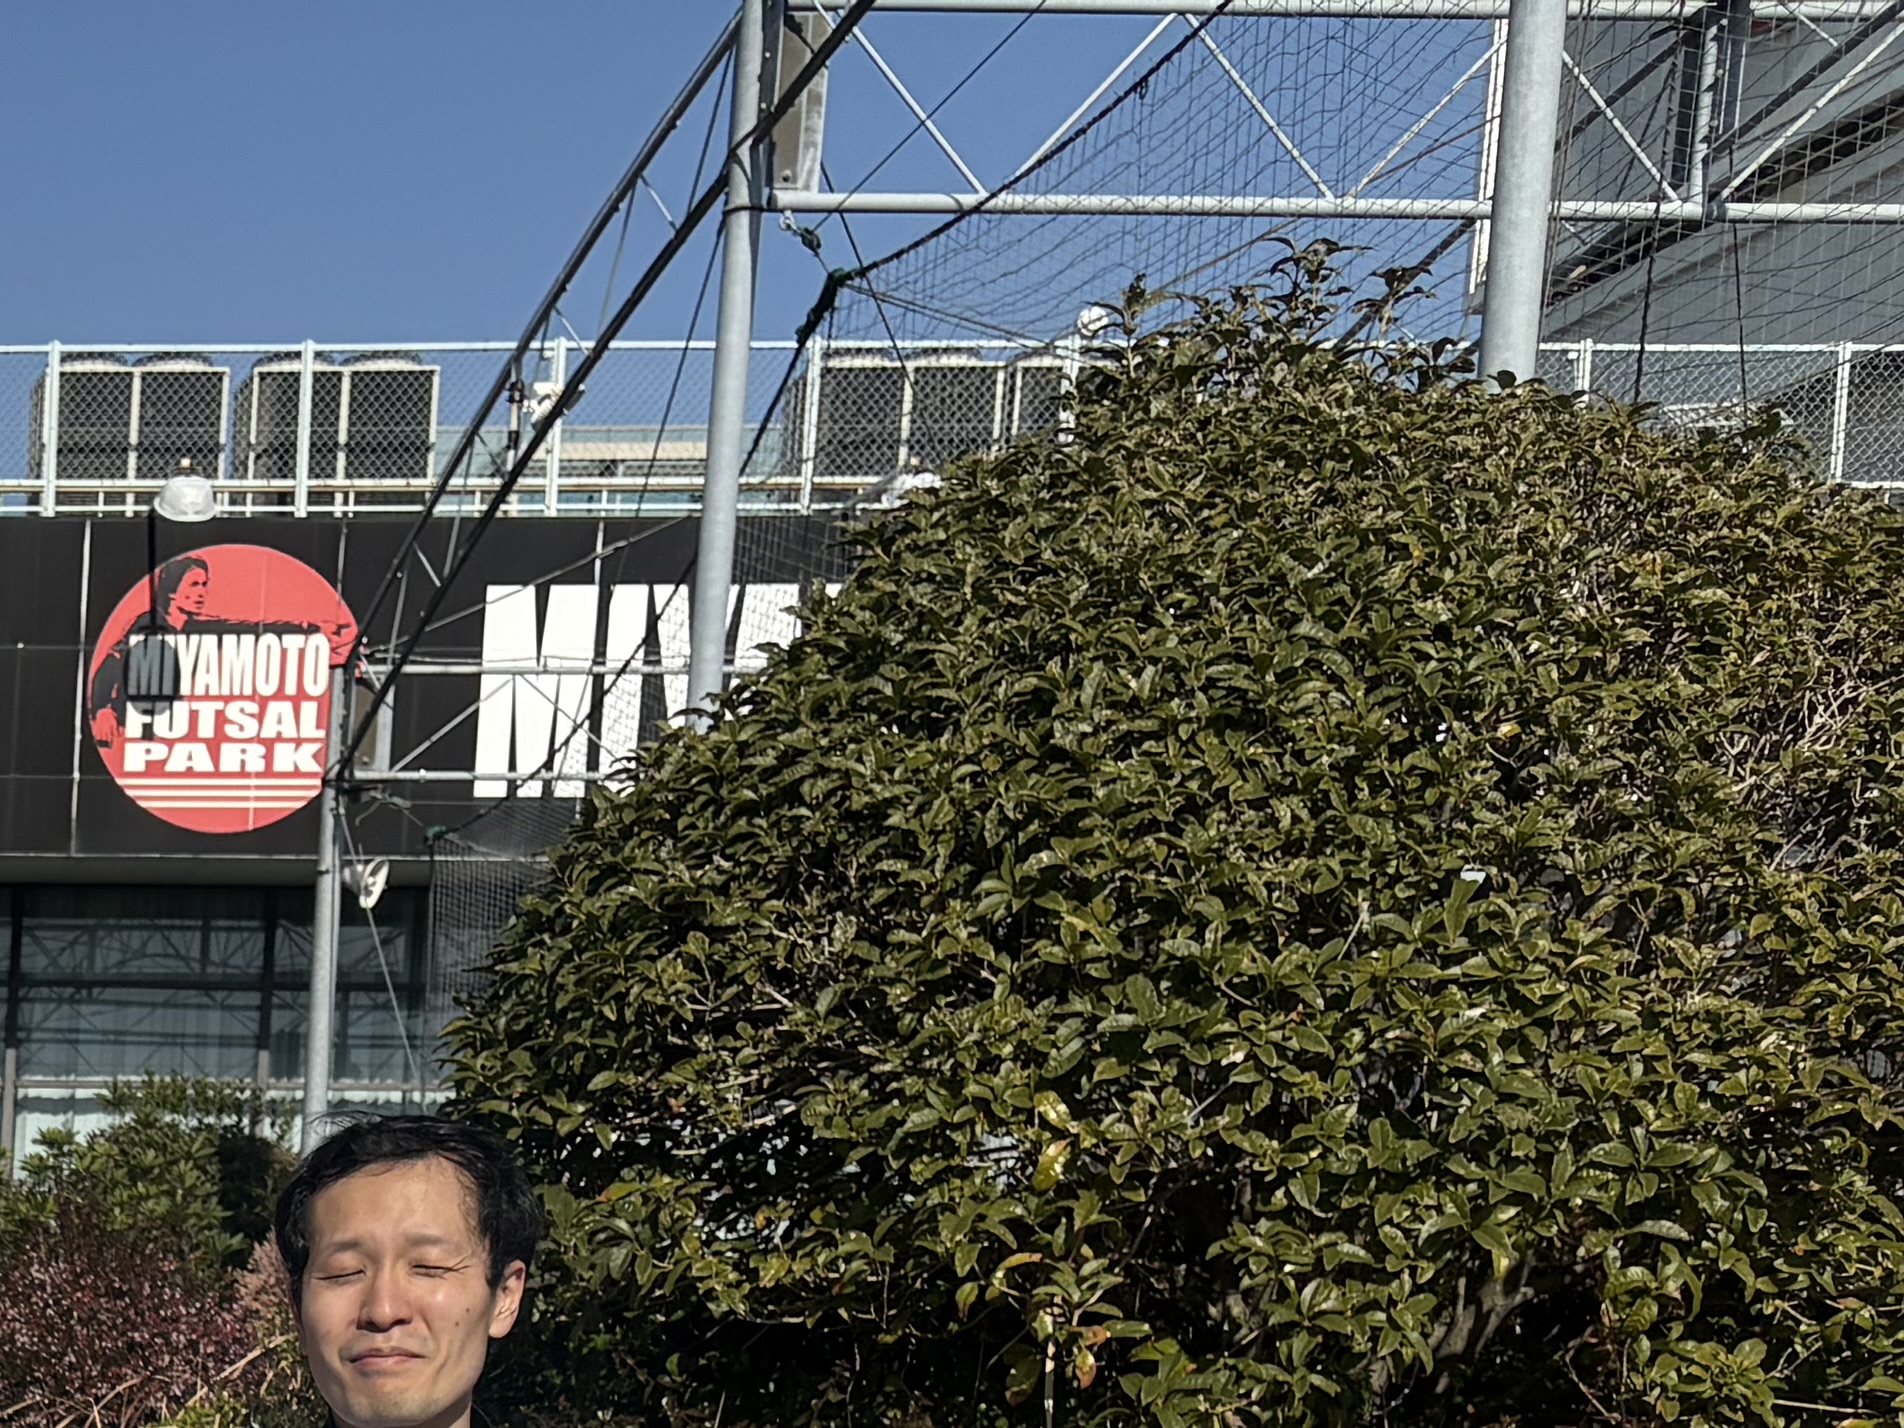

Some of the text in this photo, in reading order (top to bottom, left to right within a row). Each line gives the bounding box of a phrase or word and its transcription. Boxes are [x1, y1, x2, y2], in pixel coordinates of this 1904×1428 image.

[127, 633, 330, 697] MIYAMOTO
[124, 701, 326, 739] FUTSAL
[123, 743, 323, 773] PARK
